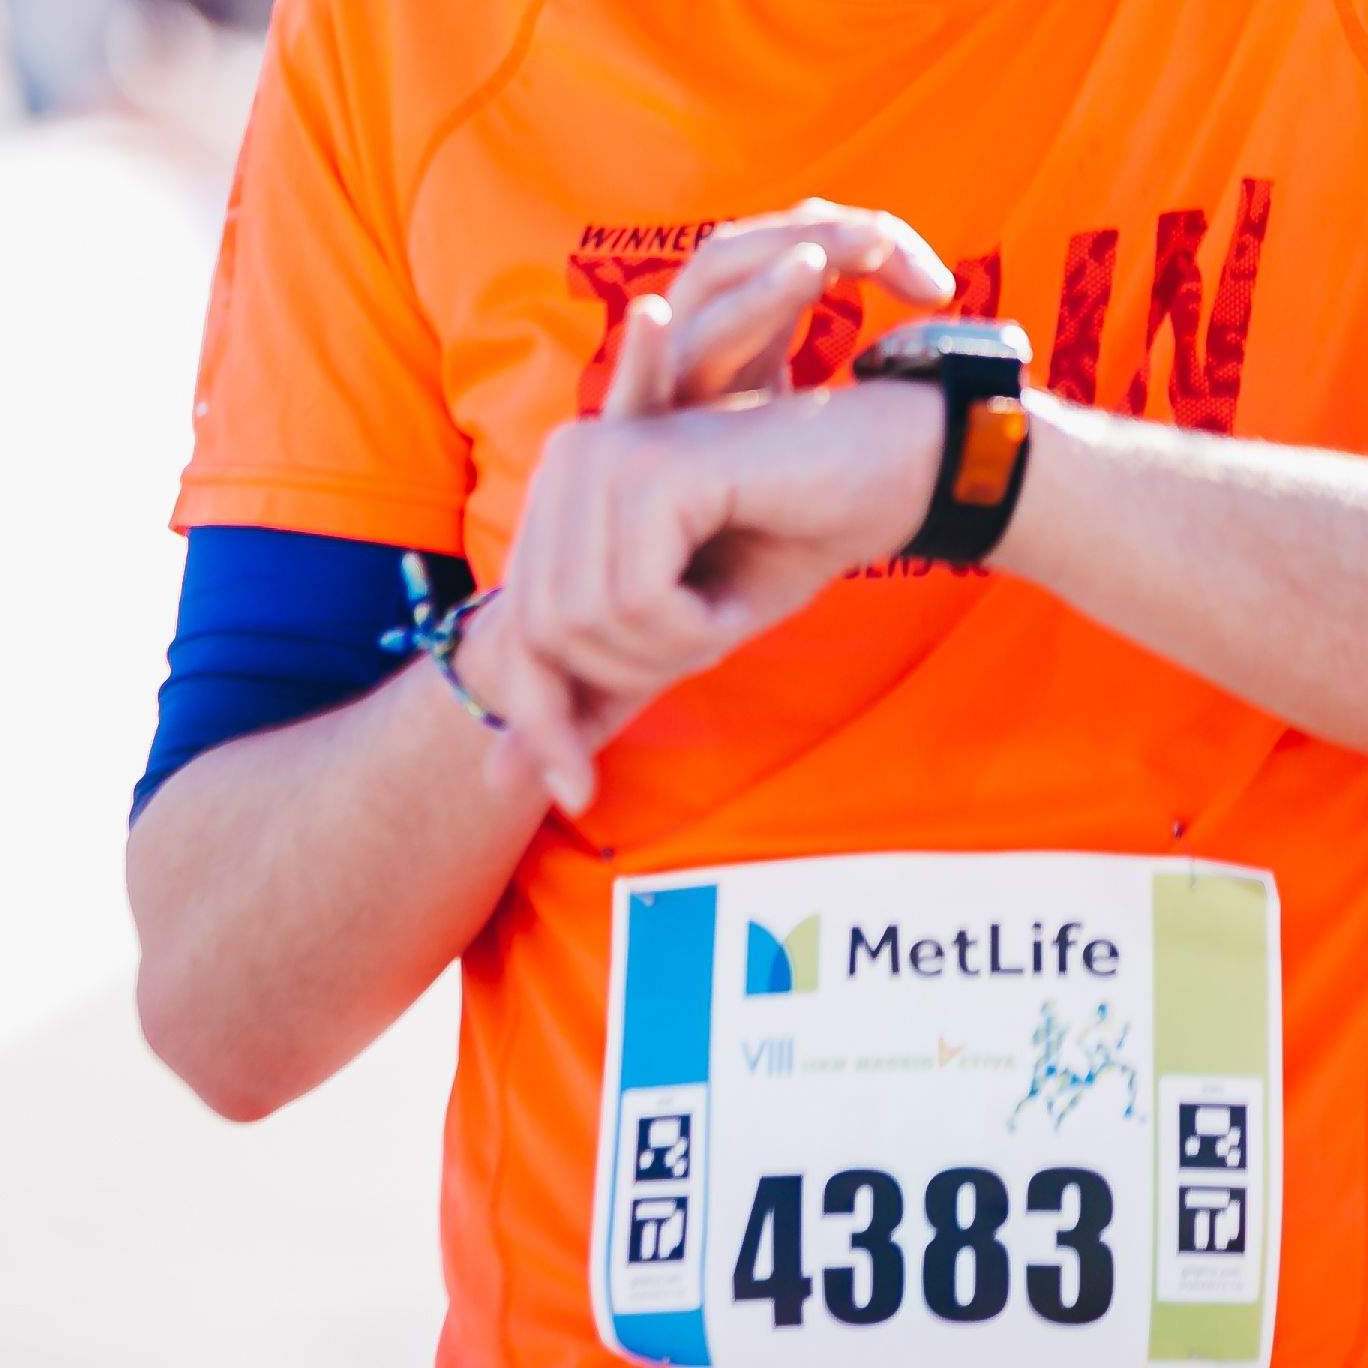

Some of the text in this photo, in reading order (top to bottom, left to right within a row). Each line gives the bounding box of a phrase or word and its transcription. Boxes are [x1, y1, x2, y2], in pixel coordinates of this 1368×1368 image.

[847, 921, 1120, 977] MetLife
[741, 1036, 795, 1077] VIII
[733, 1166, 1114, 1327] 4383
